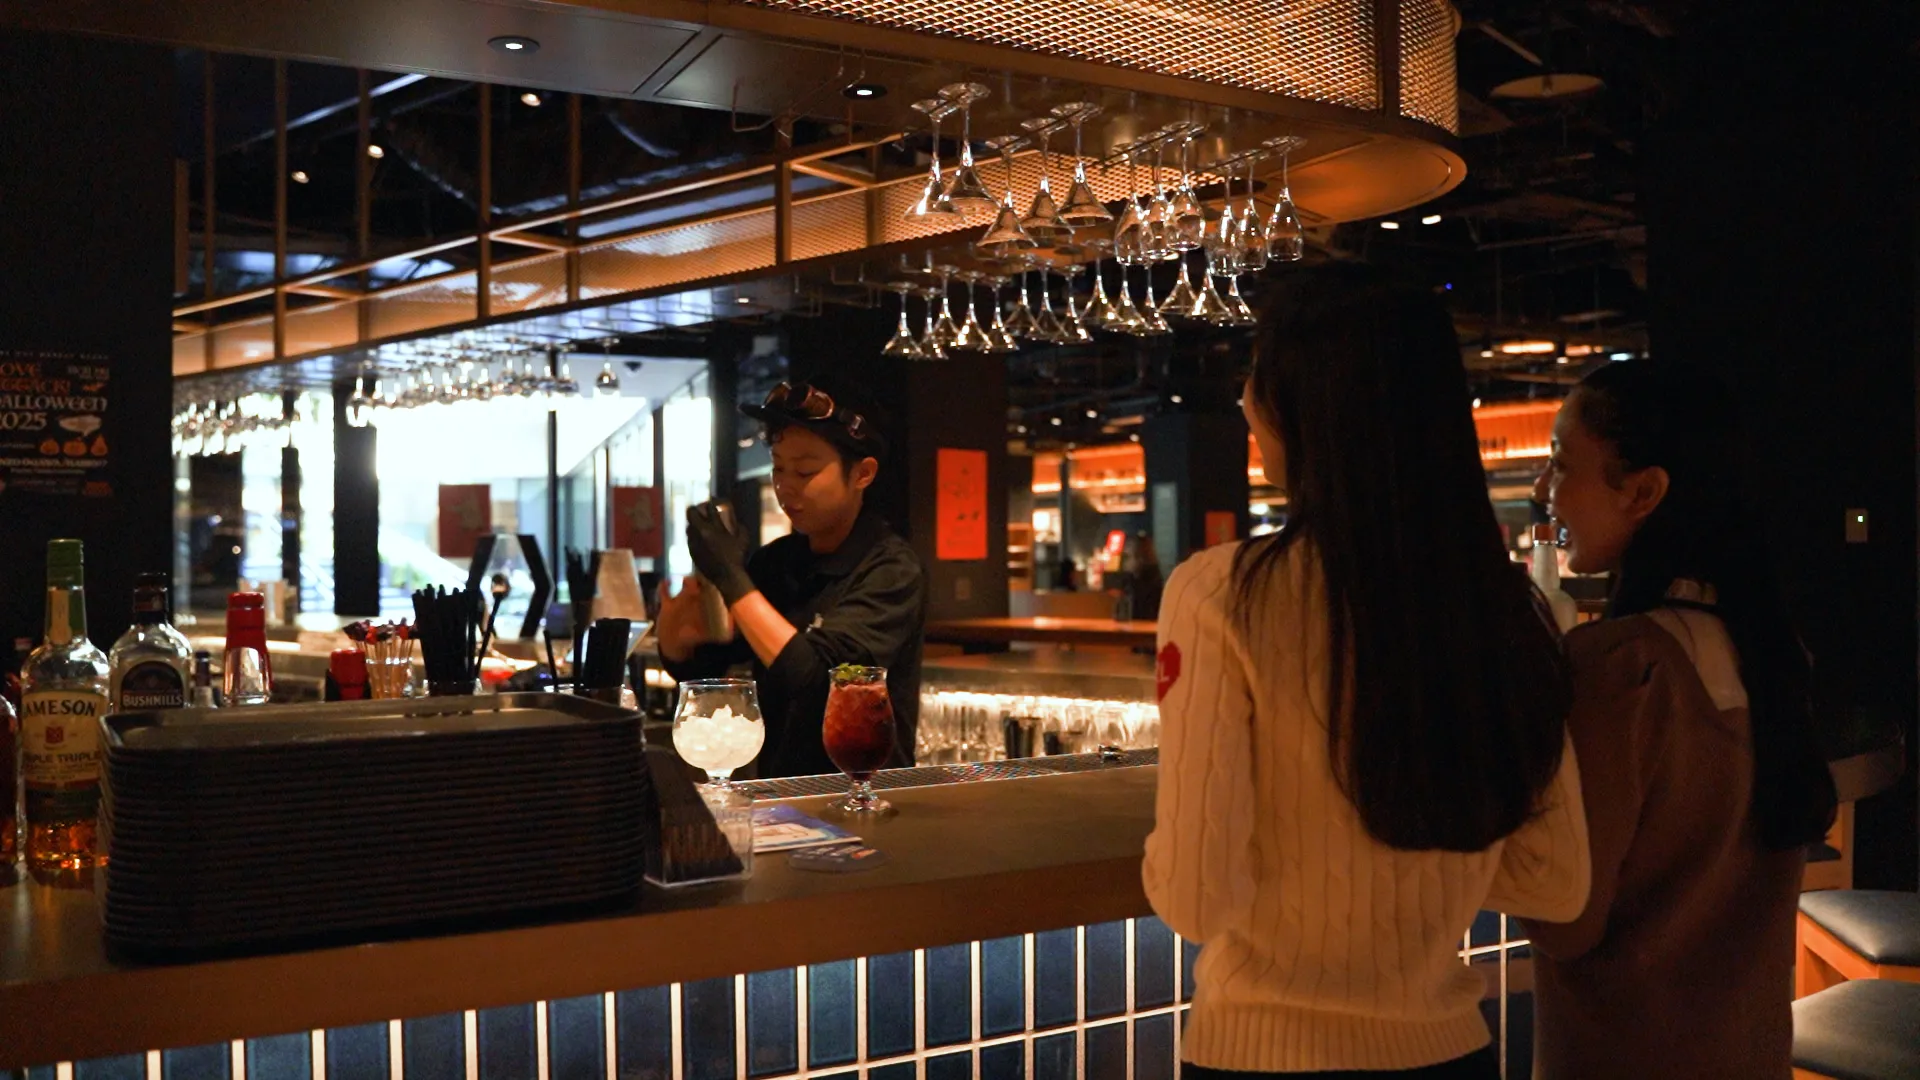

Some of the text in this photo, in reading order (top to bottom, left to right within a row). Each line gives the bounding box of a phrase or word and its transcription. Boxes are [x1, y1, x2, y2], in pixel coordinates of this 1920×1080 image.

[0, 361, 40, 377] OVE
[0, 394, 108, 412] ALLOWEEN
[0, 411, 48, 431] 025
[123, 693, 183, 707] BUSHMILLS
